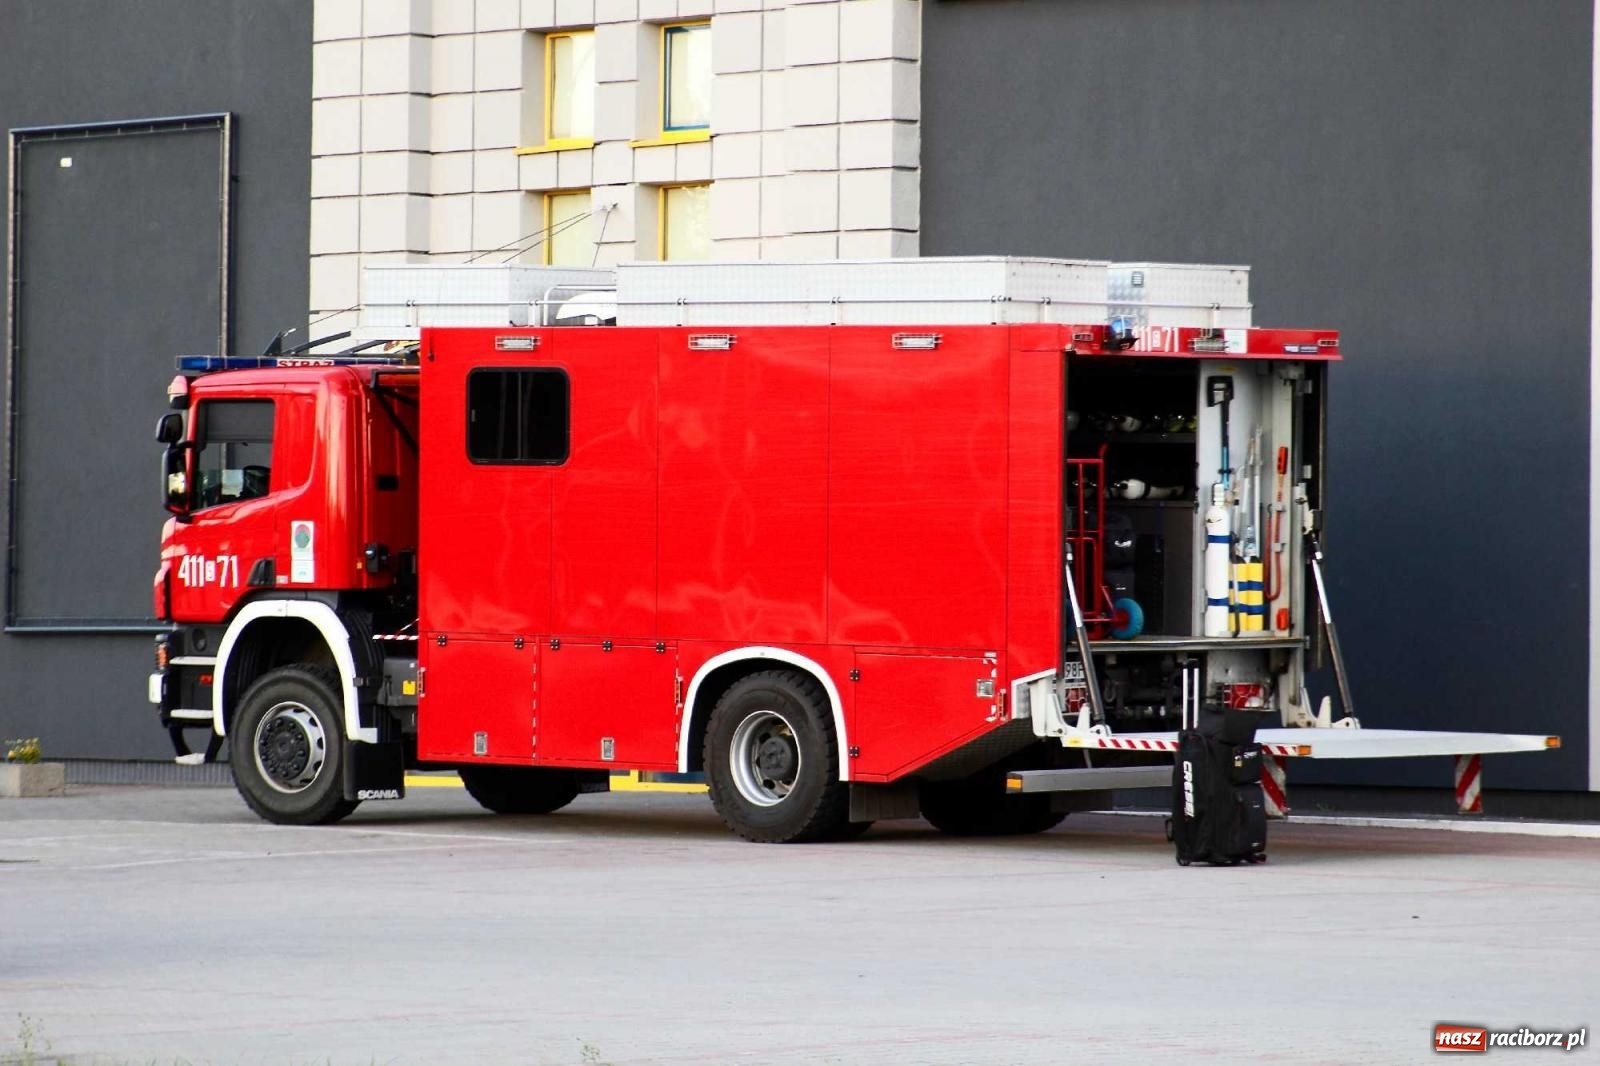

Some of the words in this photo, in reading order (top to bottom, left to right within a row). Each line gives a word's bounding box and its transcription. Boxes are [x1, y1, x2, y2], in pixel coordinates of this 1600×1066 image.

[1161, 326, 1179, 352] 71
[178, 554, 204, 588] 411
[216, 554, 238, 588] 71
[357, 789, 399, 799] SCANIA
